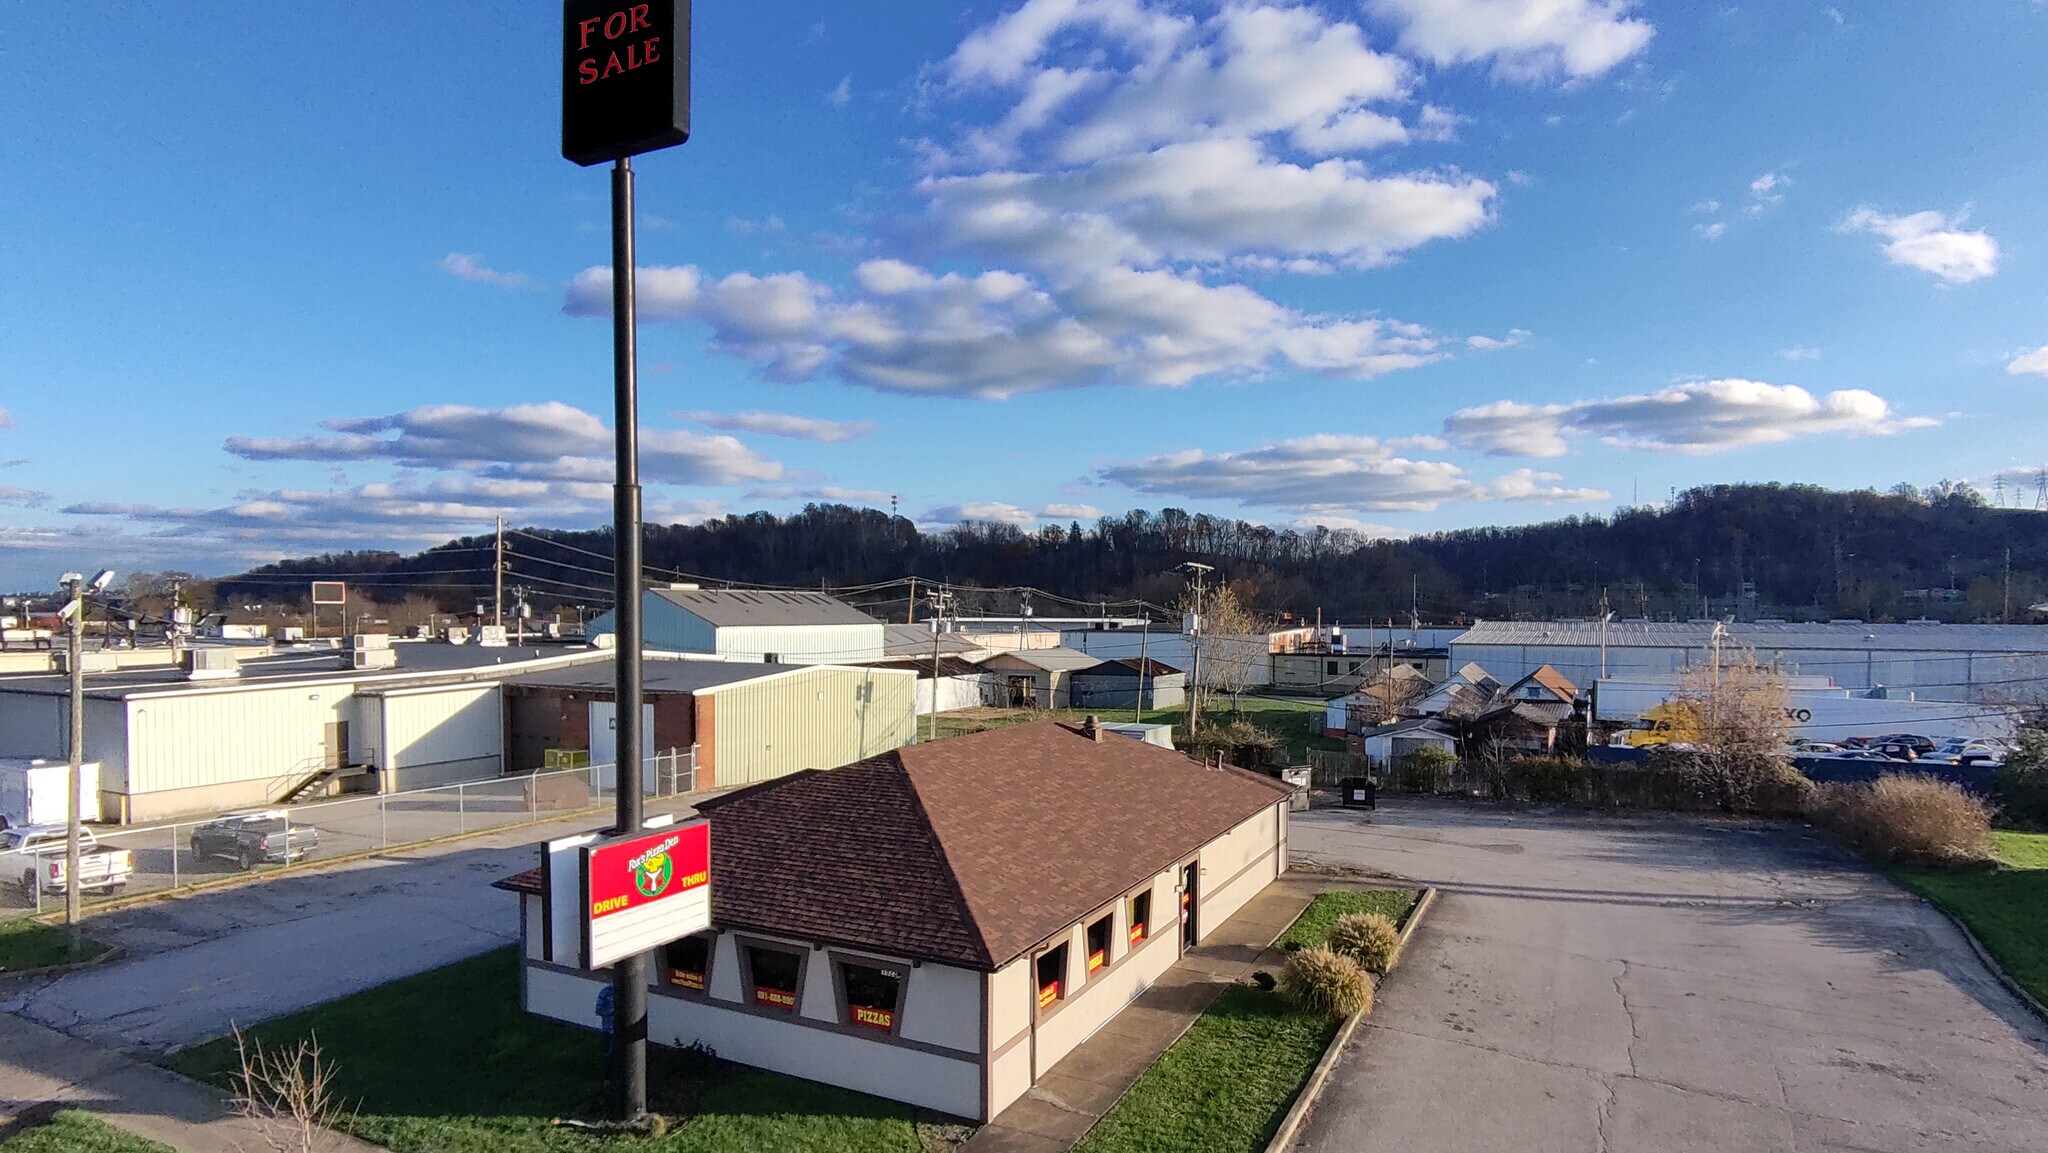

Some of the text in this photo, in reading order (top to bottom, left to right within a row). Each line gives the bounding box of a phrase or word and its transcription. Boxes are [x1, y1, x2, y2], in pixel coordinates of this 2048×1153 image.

[578, 3, 652, 51] FOR
[578, 37, 661, 85] SALE
[645, 844, 665, 861] Pizza
[664, 836, 679, 850] Den
[593, 871, 707, 914] DRIVE THRU
[857, 1009, 891, 1027] PIZZAS
